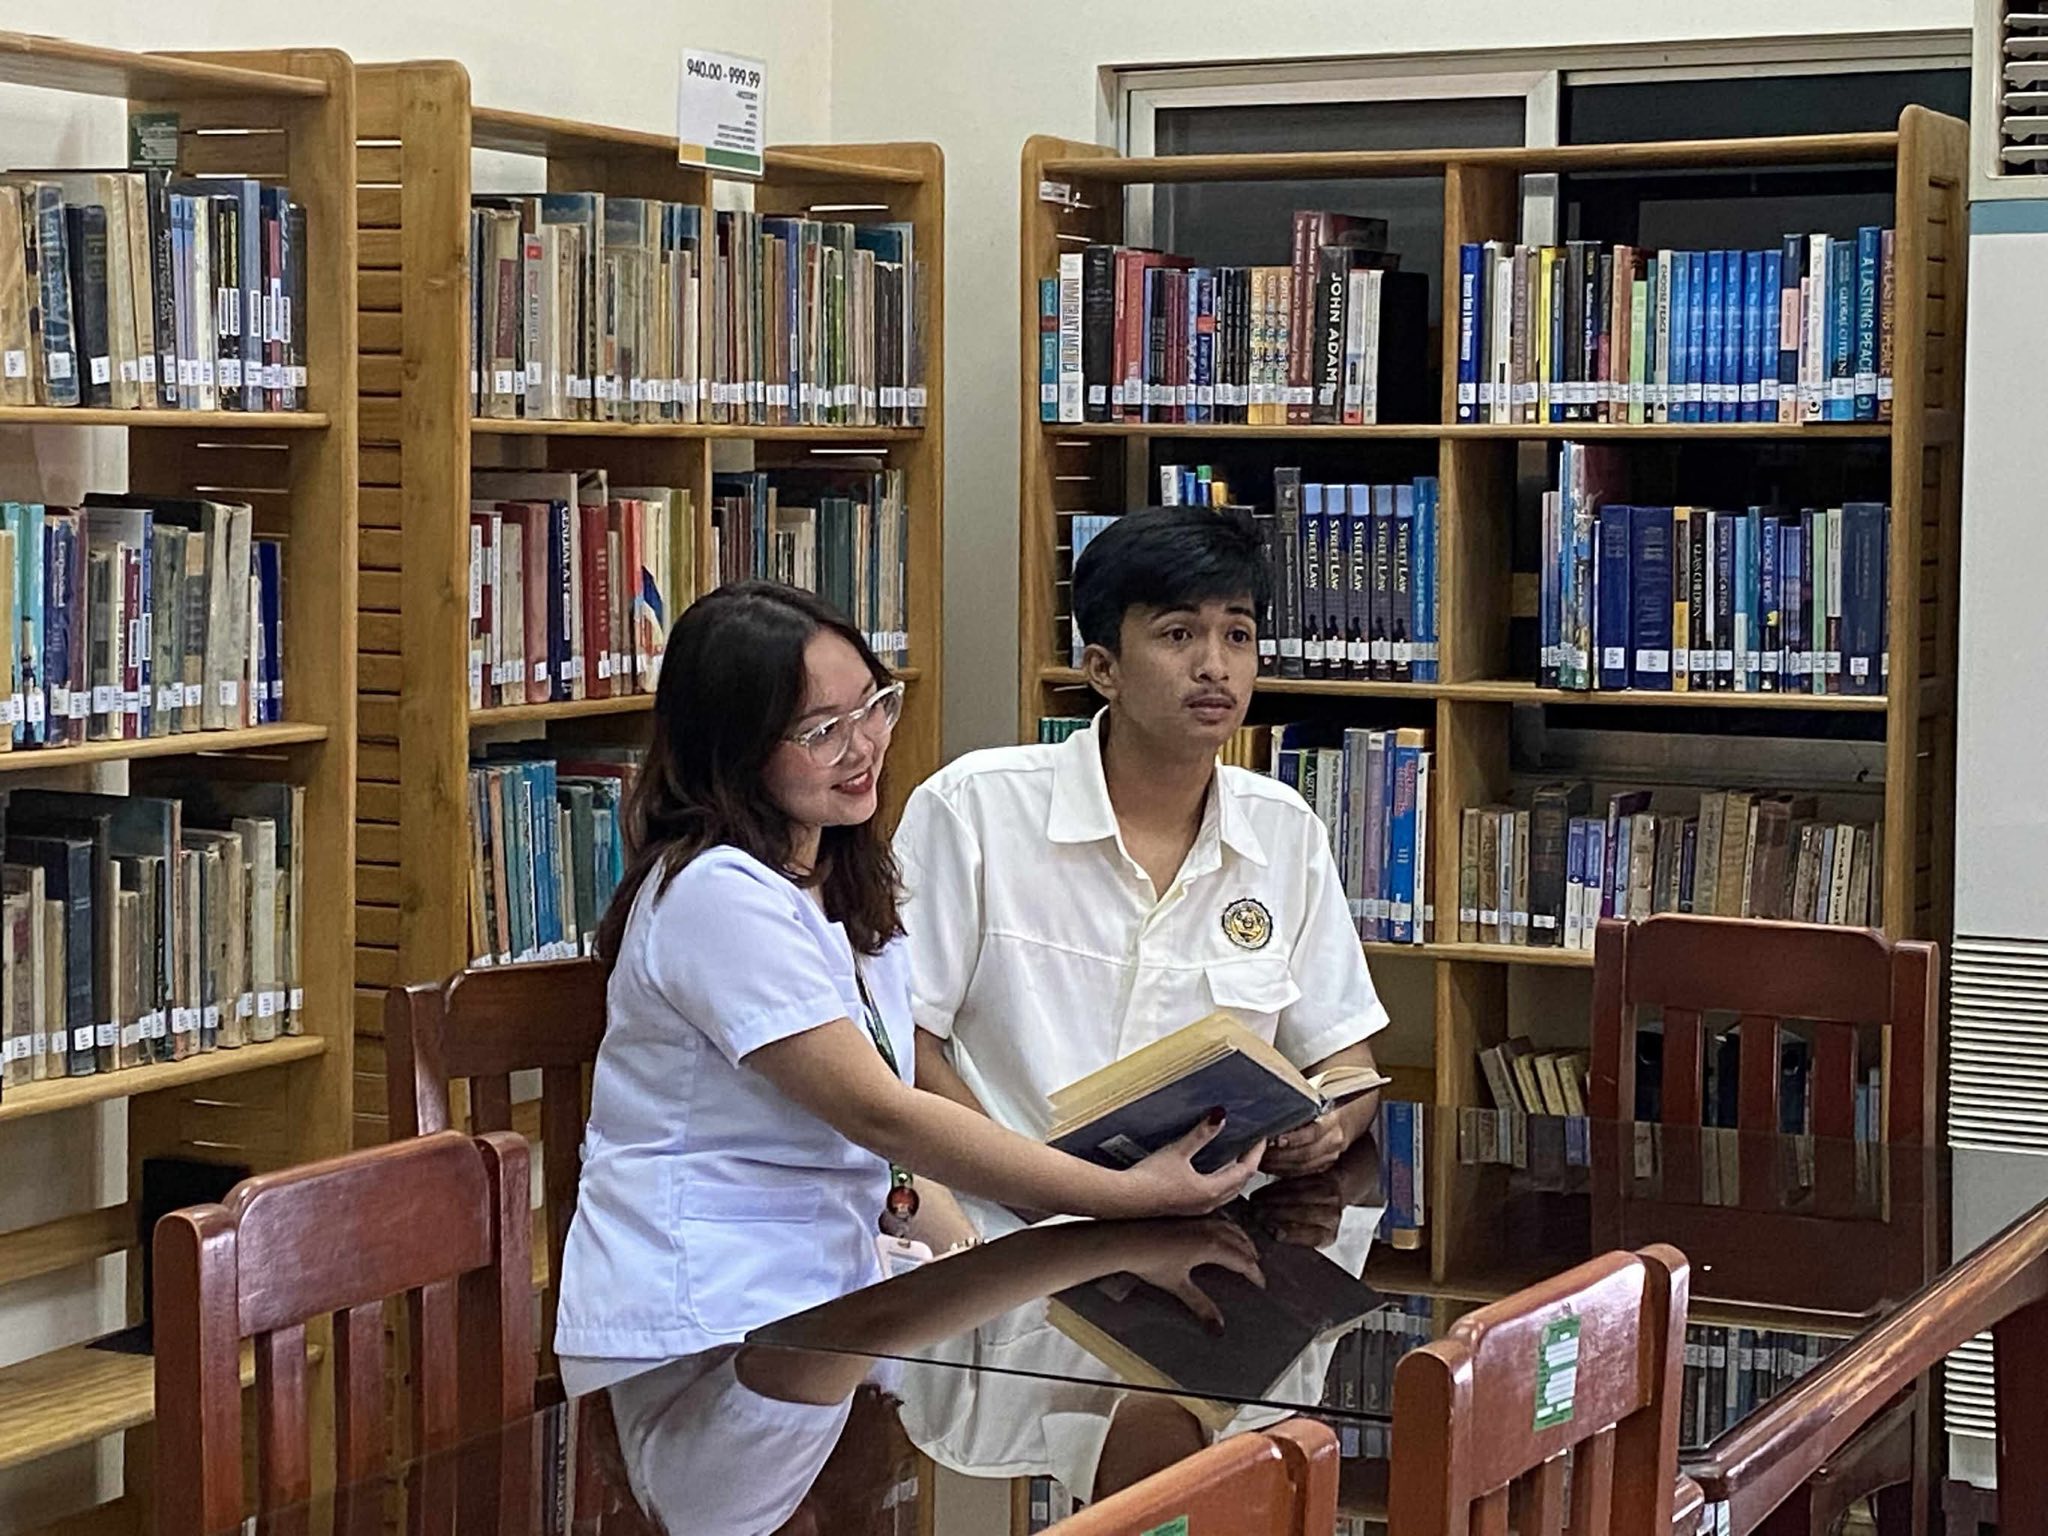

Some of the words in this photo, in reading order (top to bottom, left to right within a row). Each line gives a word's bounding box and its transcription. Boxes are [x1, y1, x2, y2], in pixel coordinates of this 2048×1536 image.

[687, 58, 722, 81] 940.00
[729, 67, 761, 89] 999.99
[1861, 257, 1874, 267] A
[1329, 272, 1342, 323] JOHN
[1860, 268, 1874, 328] LASTING
[1326, 328, 1340, 389] ADAM
[1307, 519, 1318, 561] STREET
[1329, 519, 1340, 562] STREET
[1353, 521, 1364, 563] STREET
[1377, 521, 1388, 563] STREET
[1398, 523, 1409, 565] STREET
[1307, 563, 1318, 589] LAW
[1329, 564, 1340, 592] LAW
[1353, 565, 1364, 592] LAW
[1376, 566, 1388, 592] LAW
[1397, 567, 1409, 594] LAW
